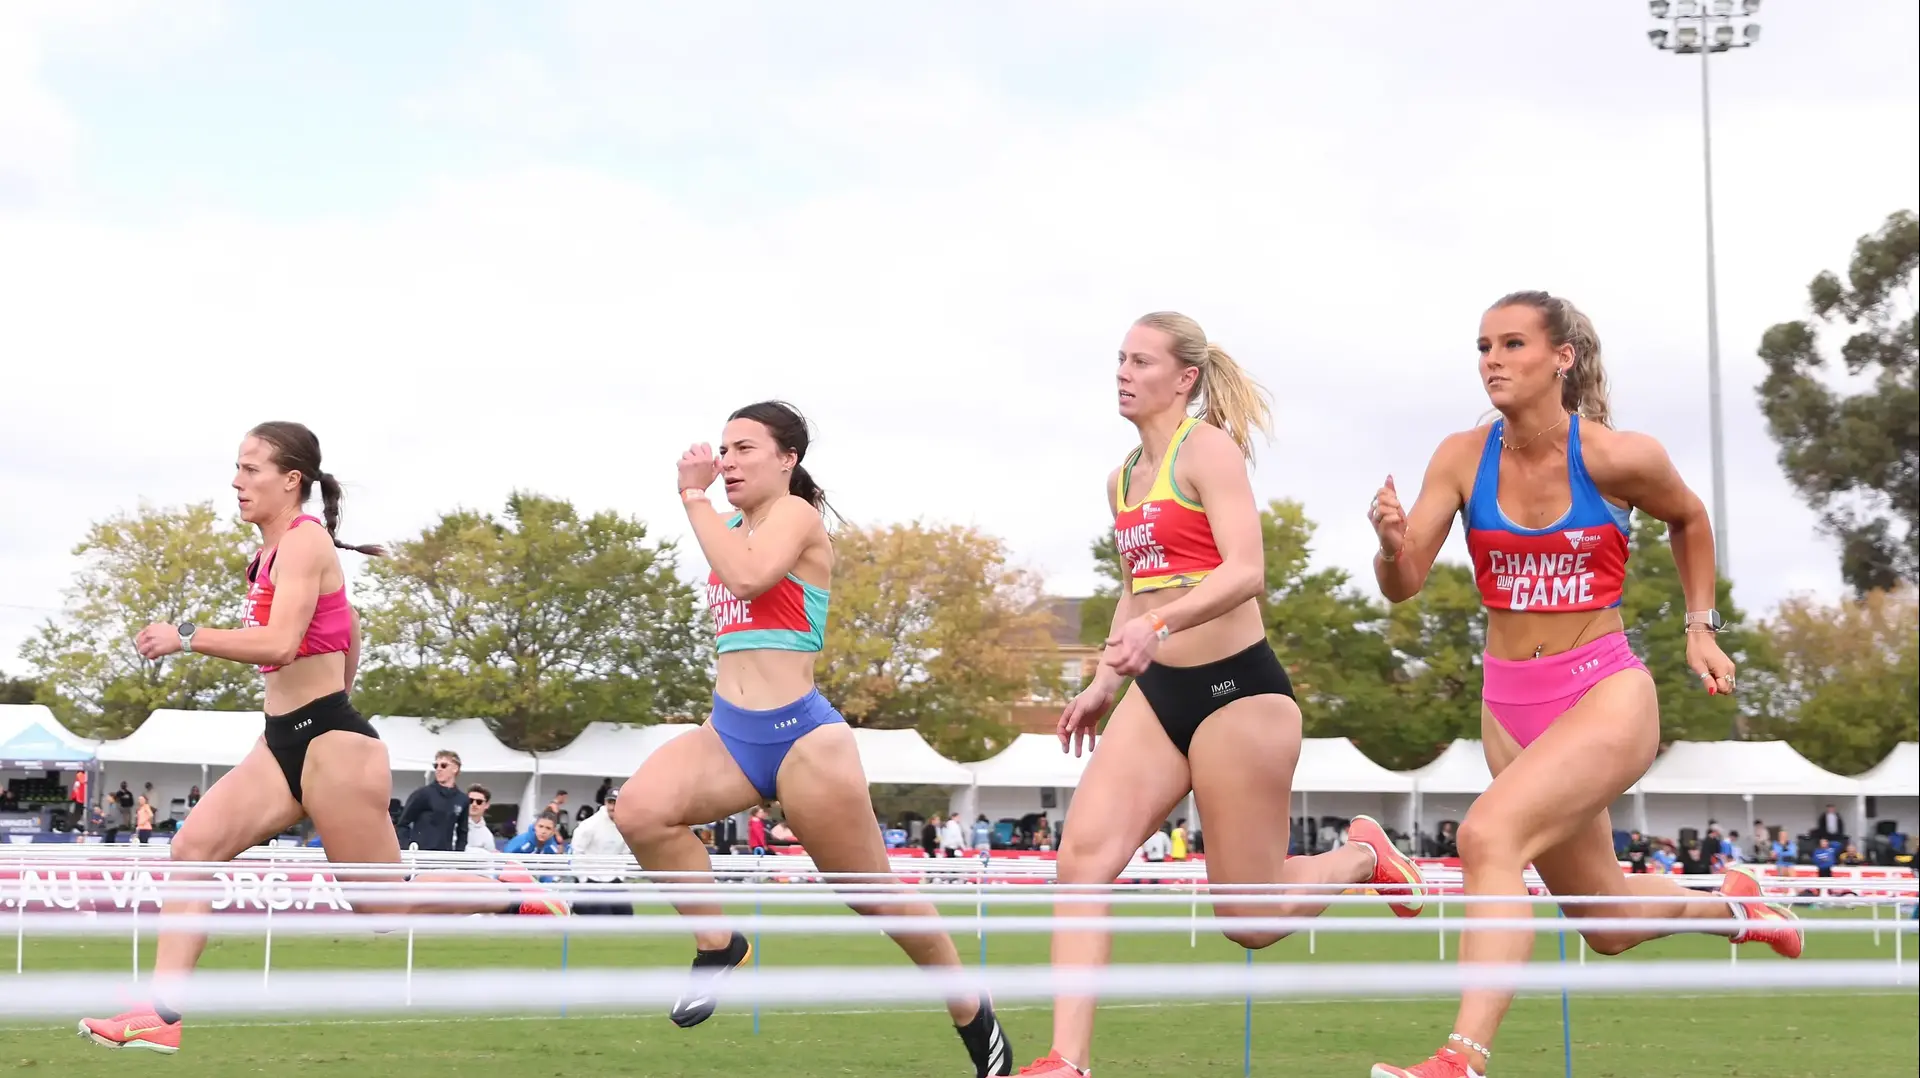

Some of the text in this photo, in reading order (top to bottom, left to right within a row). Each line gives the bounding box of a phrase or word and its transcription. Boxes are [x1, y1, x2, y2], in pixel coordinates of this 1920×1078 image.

[1489, 550, 1592, 577] CHANGE
[1496, 572, 1595, 610] OUR GAME
